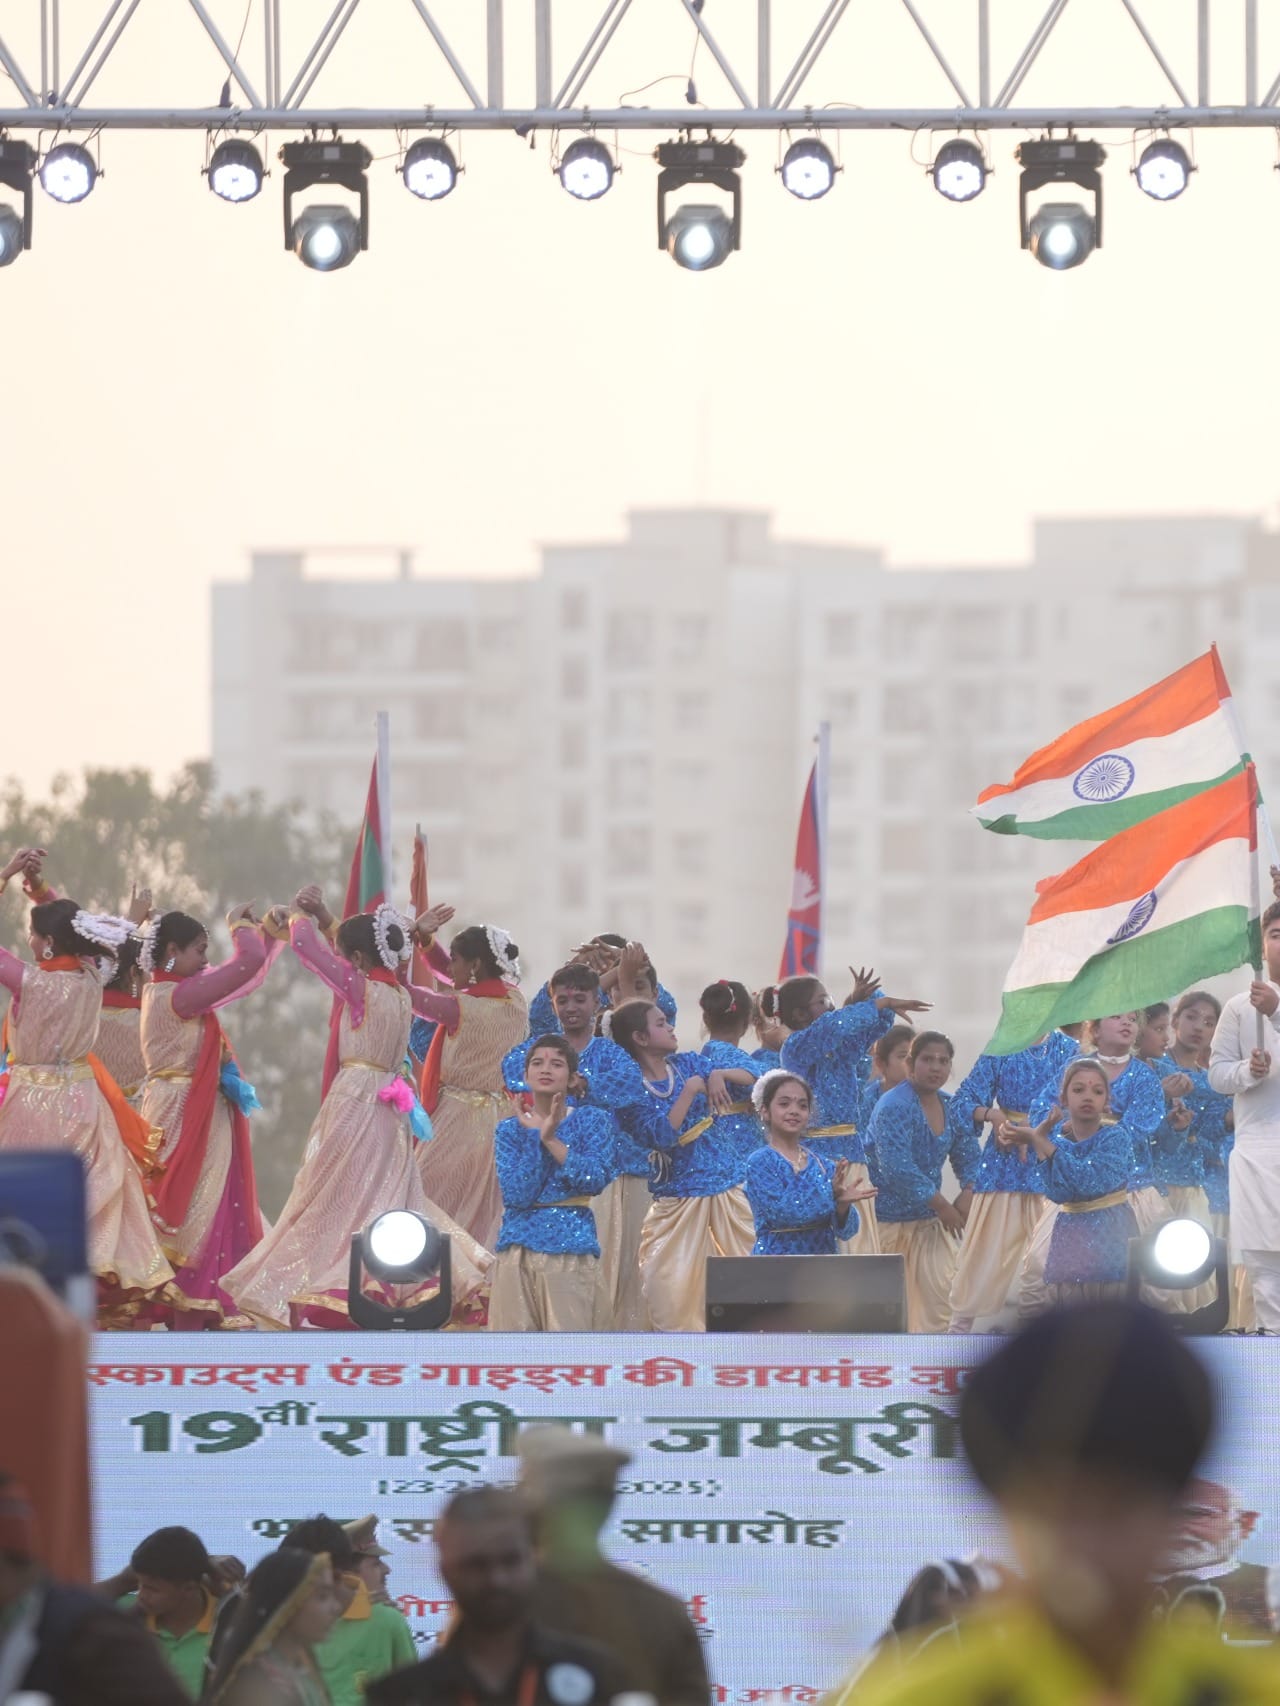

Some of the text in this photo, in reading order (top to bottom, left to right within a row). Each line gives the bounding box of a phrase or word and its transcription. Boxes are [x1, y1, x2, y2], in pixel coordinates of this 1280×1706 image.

[327, 1356, 406, 1386] एंड
[623, 1356, 697, 1387] की
[713, 1358, 893, 1388] डायमंड
[644, 1401, 964, 1474] जम्बूरी
[620, 1510, 845, 1548] समारोह
